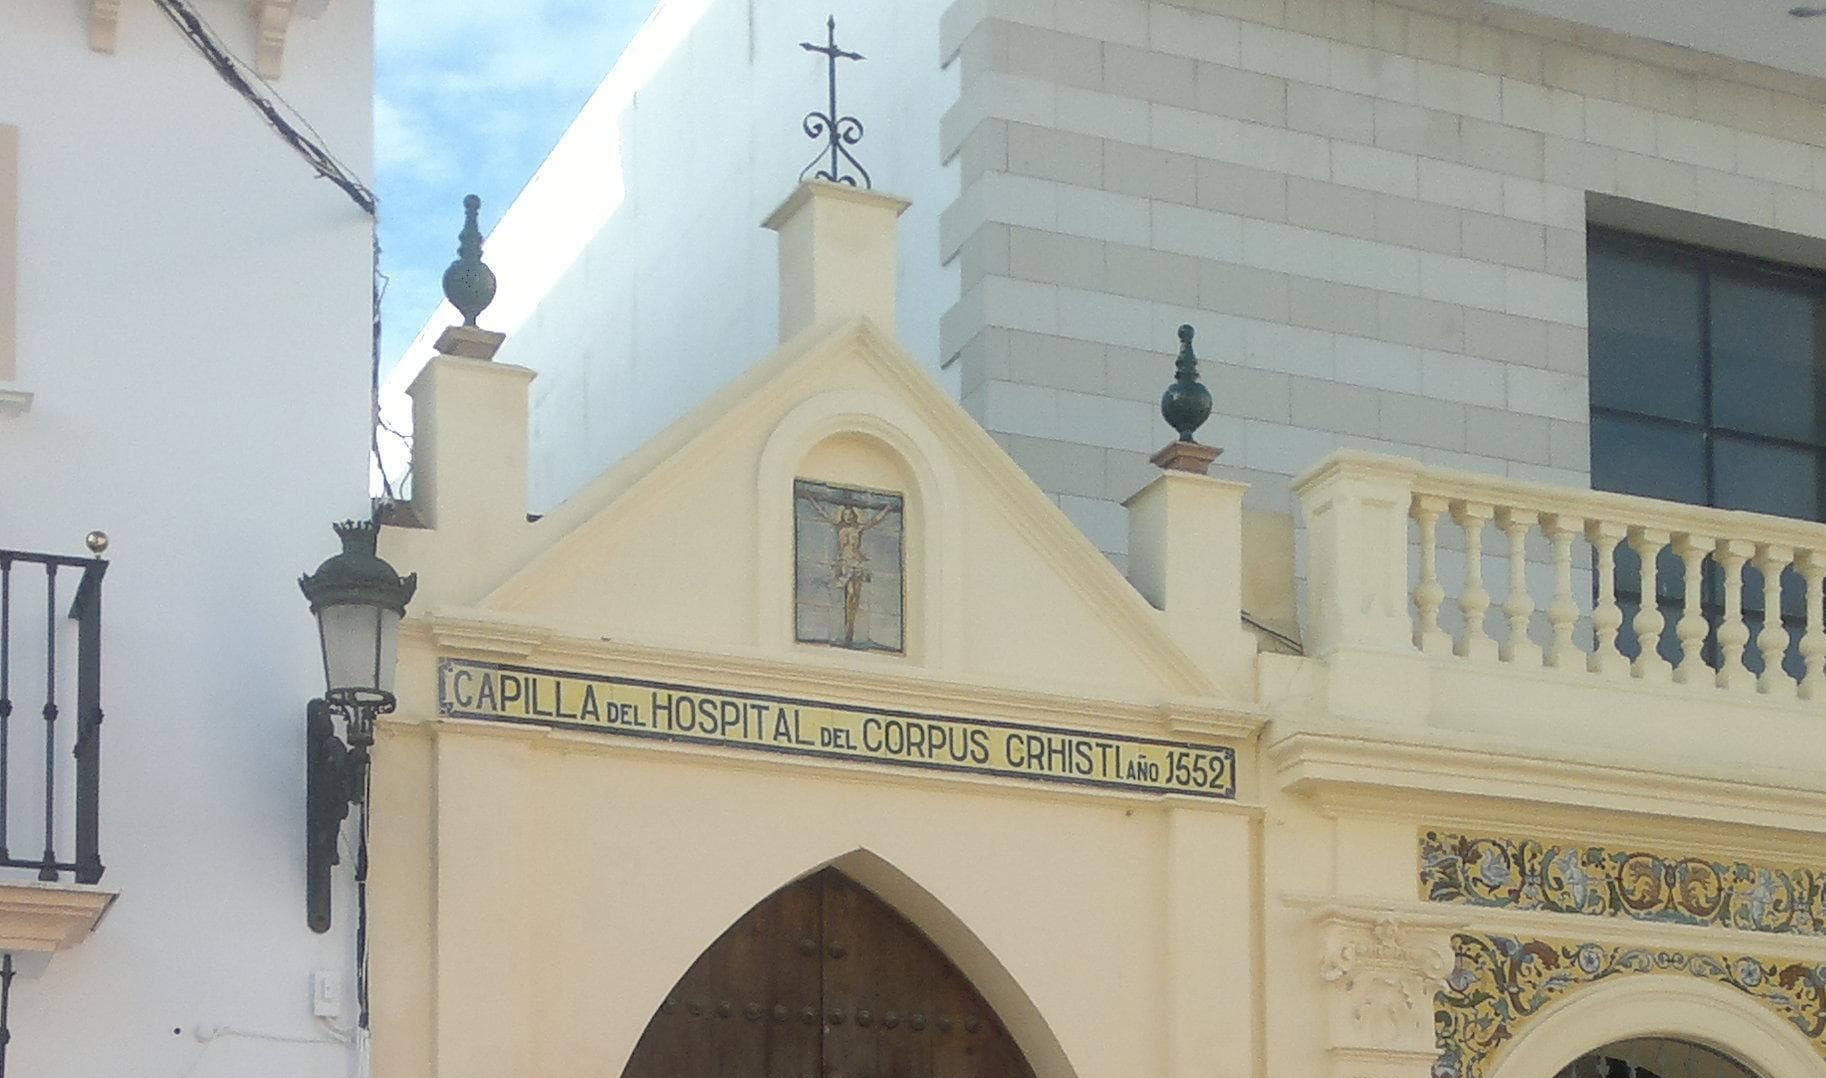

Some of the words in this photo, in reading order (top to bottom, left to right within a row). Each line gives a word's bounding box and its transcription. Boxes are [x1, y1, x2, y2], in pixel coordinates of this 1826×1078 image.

[453, 669, 600, 722] CAPILLA
[606, 701, 646, 727] DEL
[651, 691, 815, 746] HOSPITAL
[820, 726, 858, 750] DEL
[862, 717, 989, 764] CORPUS
[1005, 733, 1124, 779] CRHISTI
[1126, 753, 1159, 783] AÑO
[1164, 751, 1225, 789] 1552
